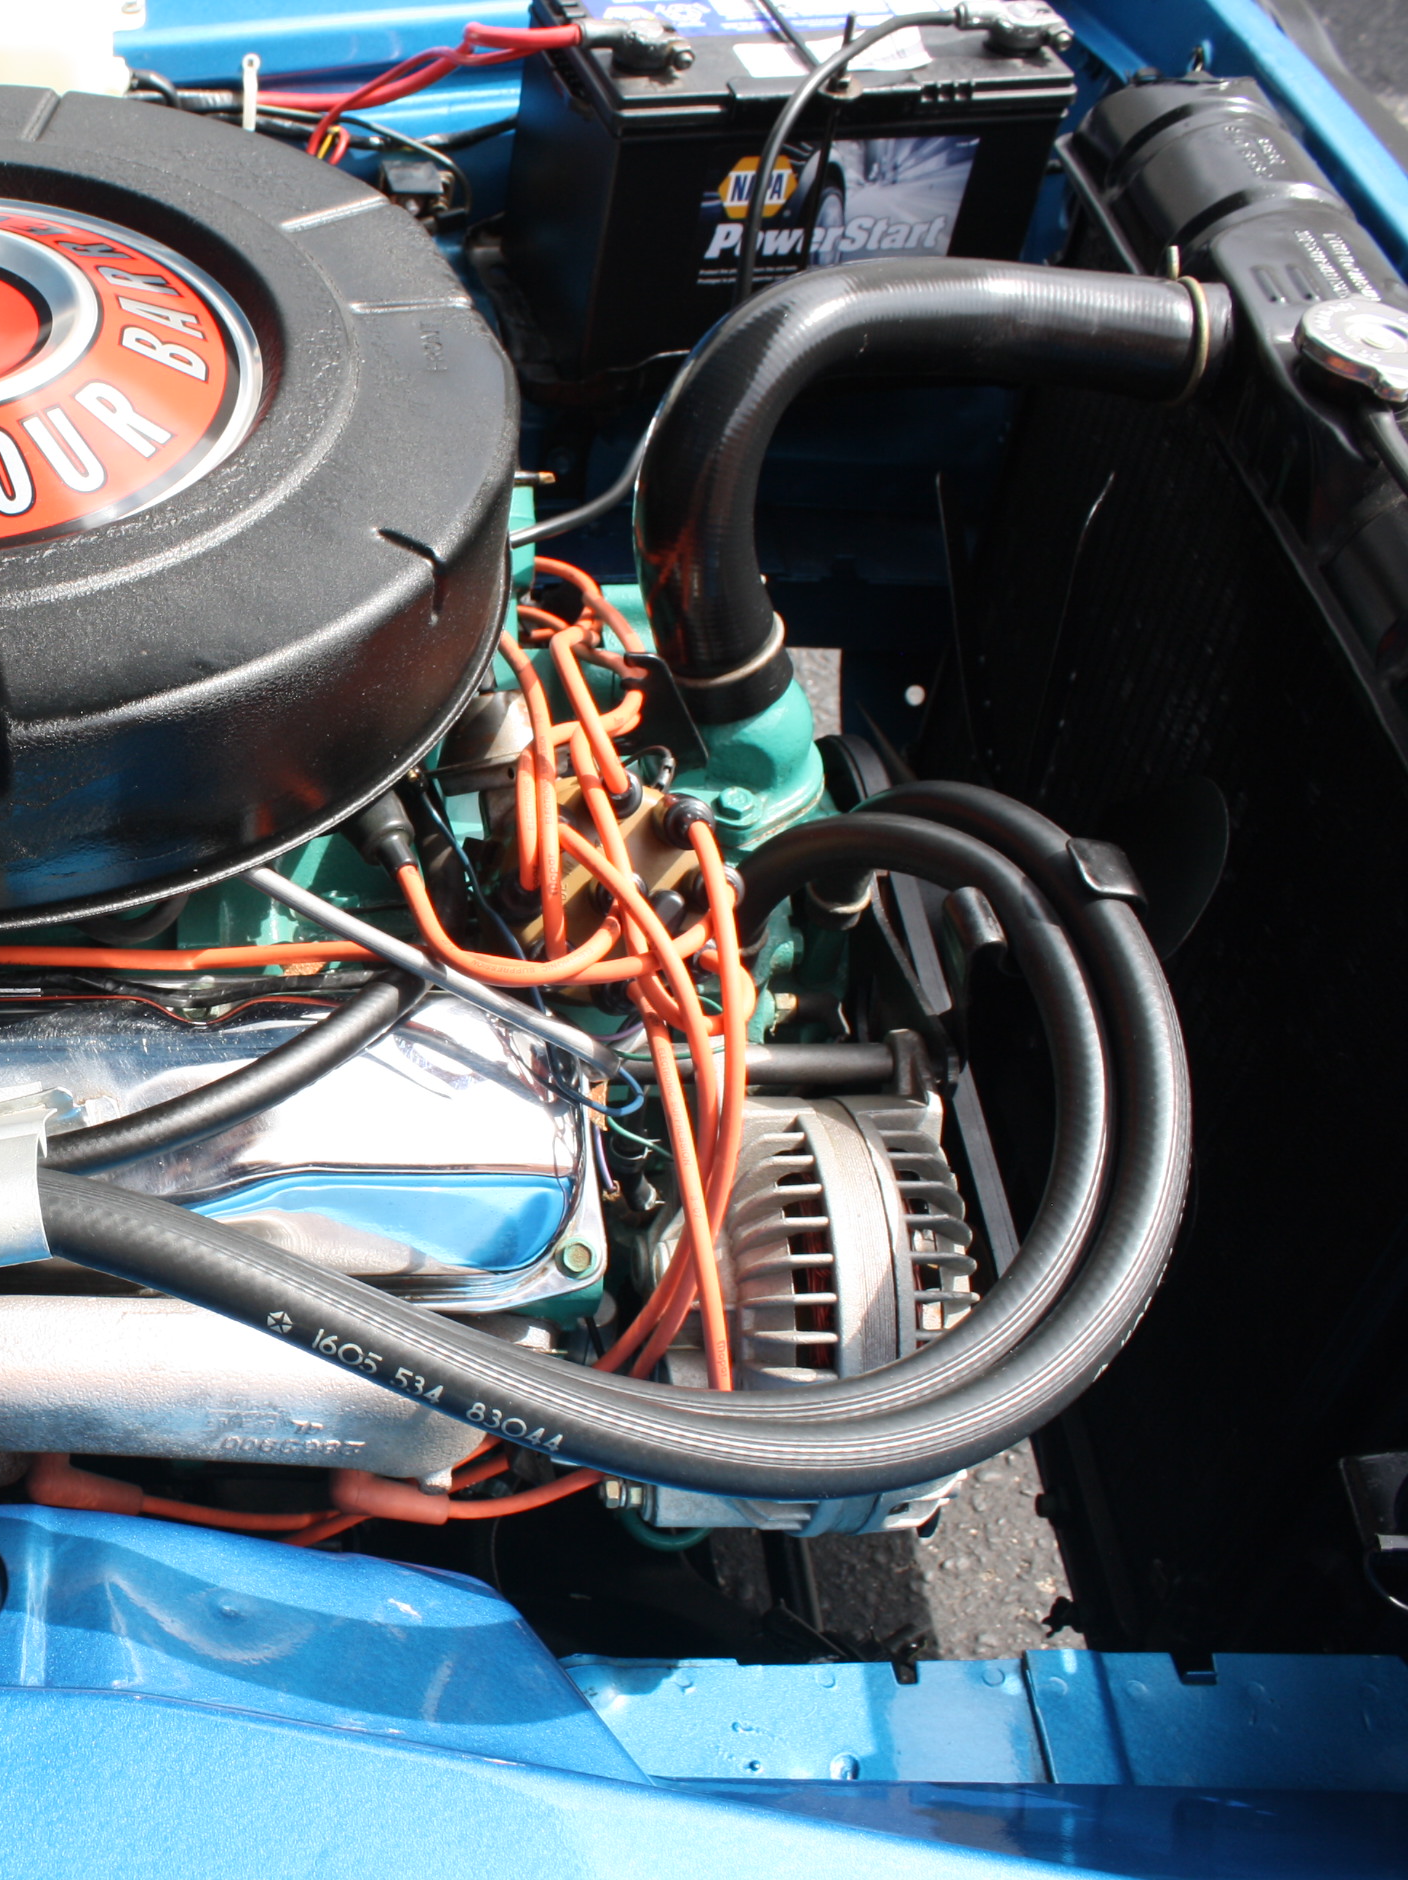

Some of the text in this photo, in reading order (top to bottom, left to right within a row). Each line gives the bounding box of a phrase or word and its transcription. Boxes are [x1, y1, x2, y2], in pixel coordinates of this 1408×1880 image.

[731, 172, 784, 202] NA
[311, 1328, 564, 1452] 1605 534 83044
